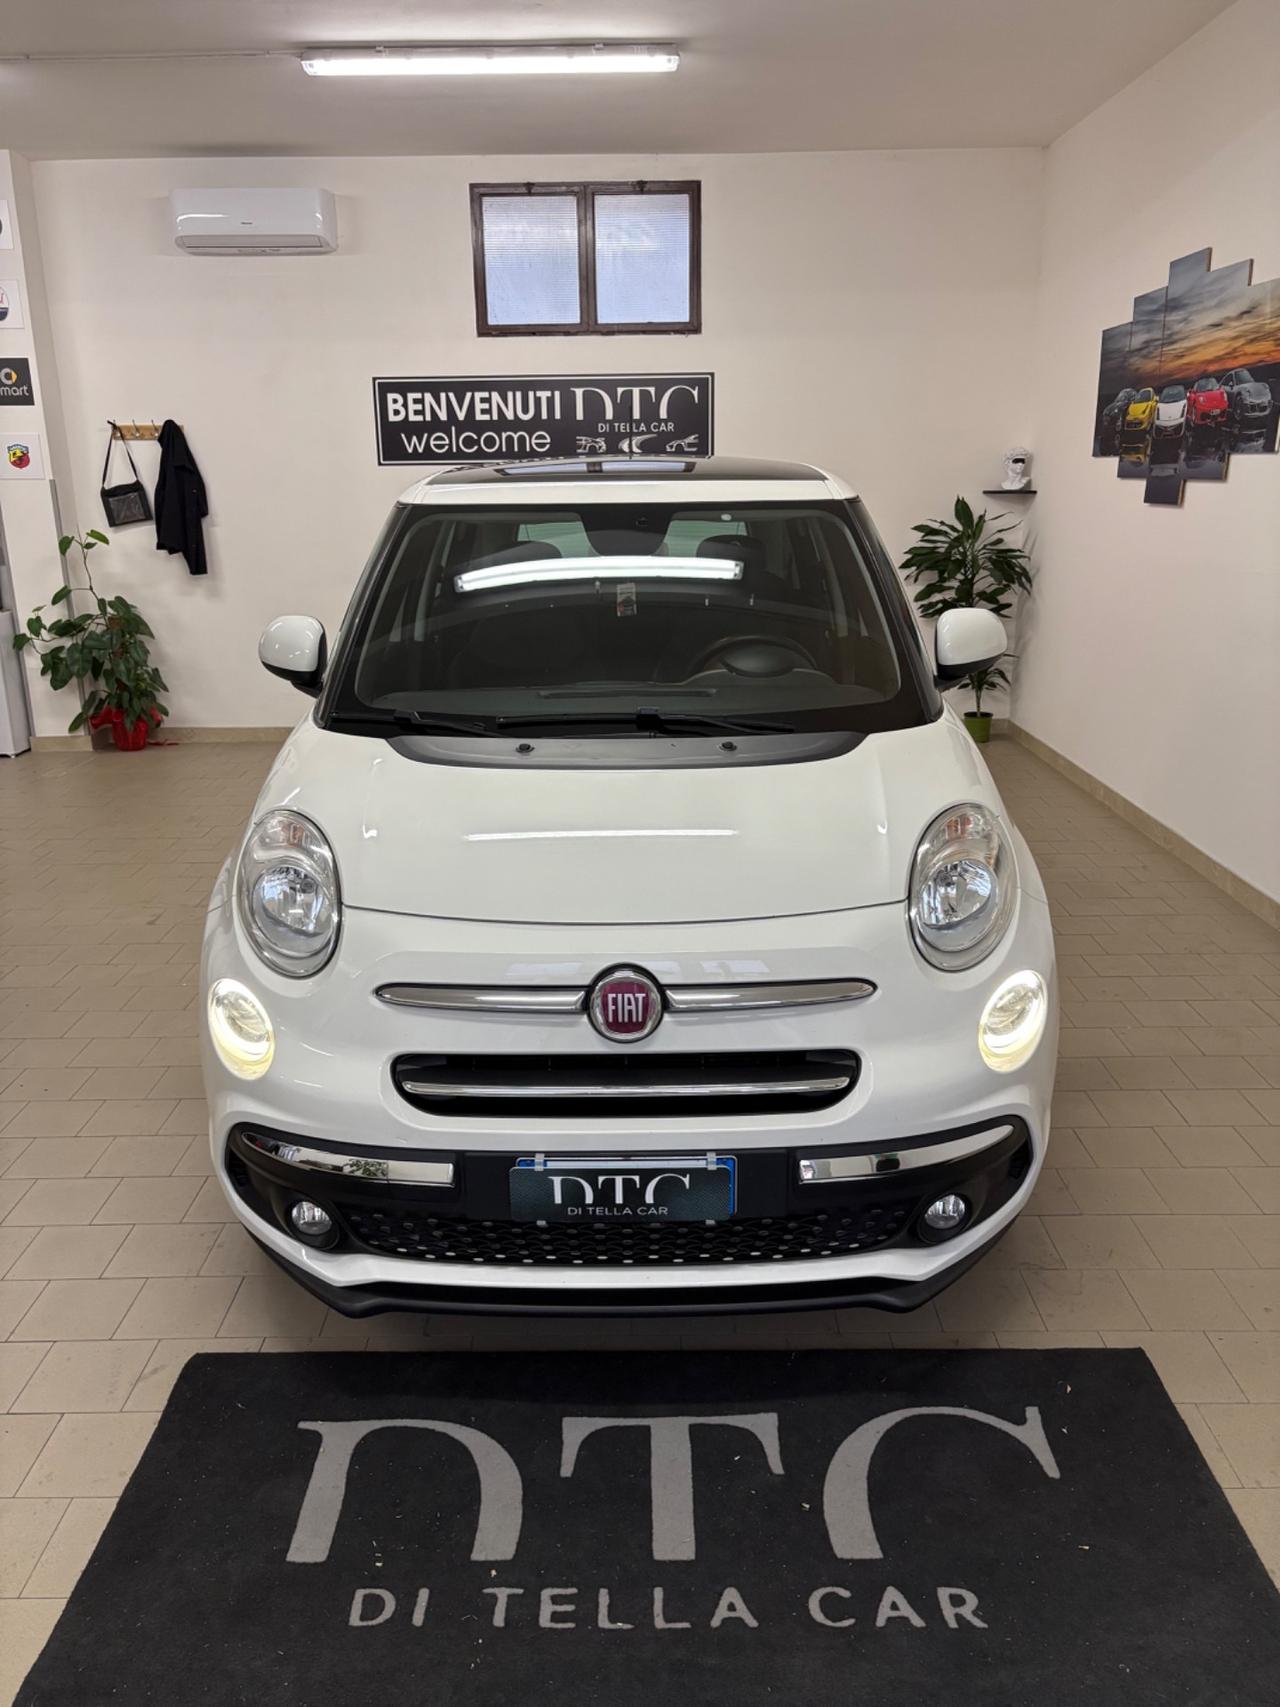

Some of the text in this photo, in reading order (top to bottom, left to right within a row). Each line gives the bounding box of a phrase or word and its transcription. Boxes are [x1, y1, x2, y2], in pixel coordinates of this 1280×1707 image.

[0, 385, 29, 396] mart
[386, 390, 561, 422] BENVENUTI
[570, 385, 699, 420] DTC
[401, 426, 551, 454] welcome
[598, 423, 609, 433] DI
[650, 422, 675, 432] CAR
[607, 993, 646, 1023] FIAT
[548, 1173, 690, 1205] DTC
[567, 1207, 669, 1216] DI TELLA CAR
[286, 1406, 1061, 1564] DTC
[348, 1586, 989, 1630] DI TELLA CAR
